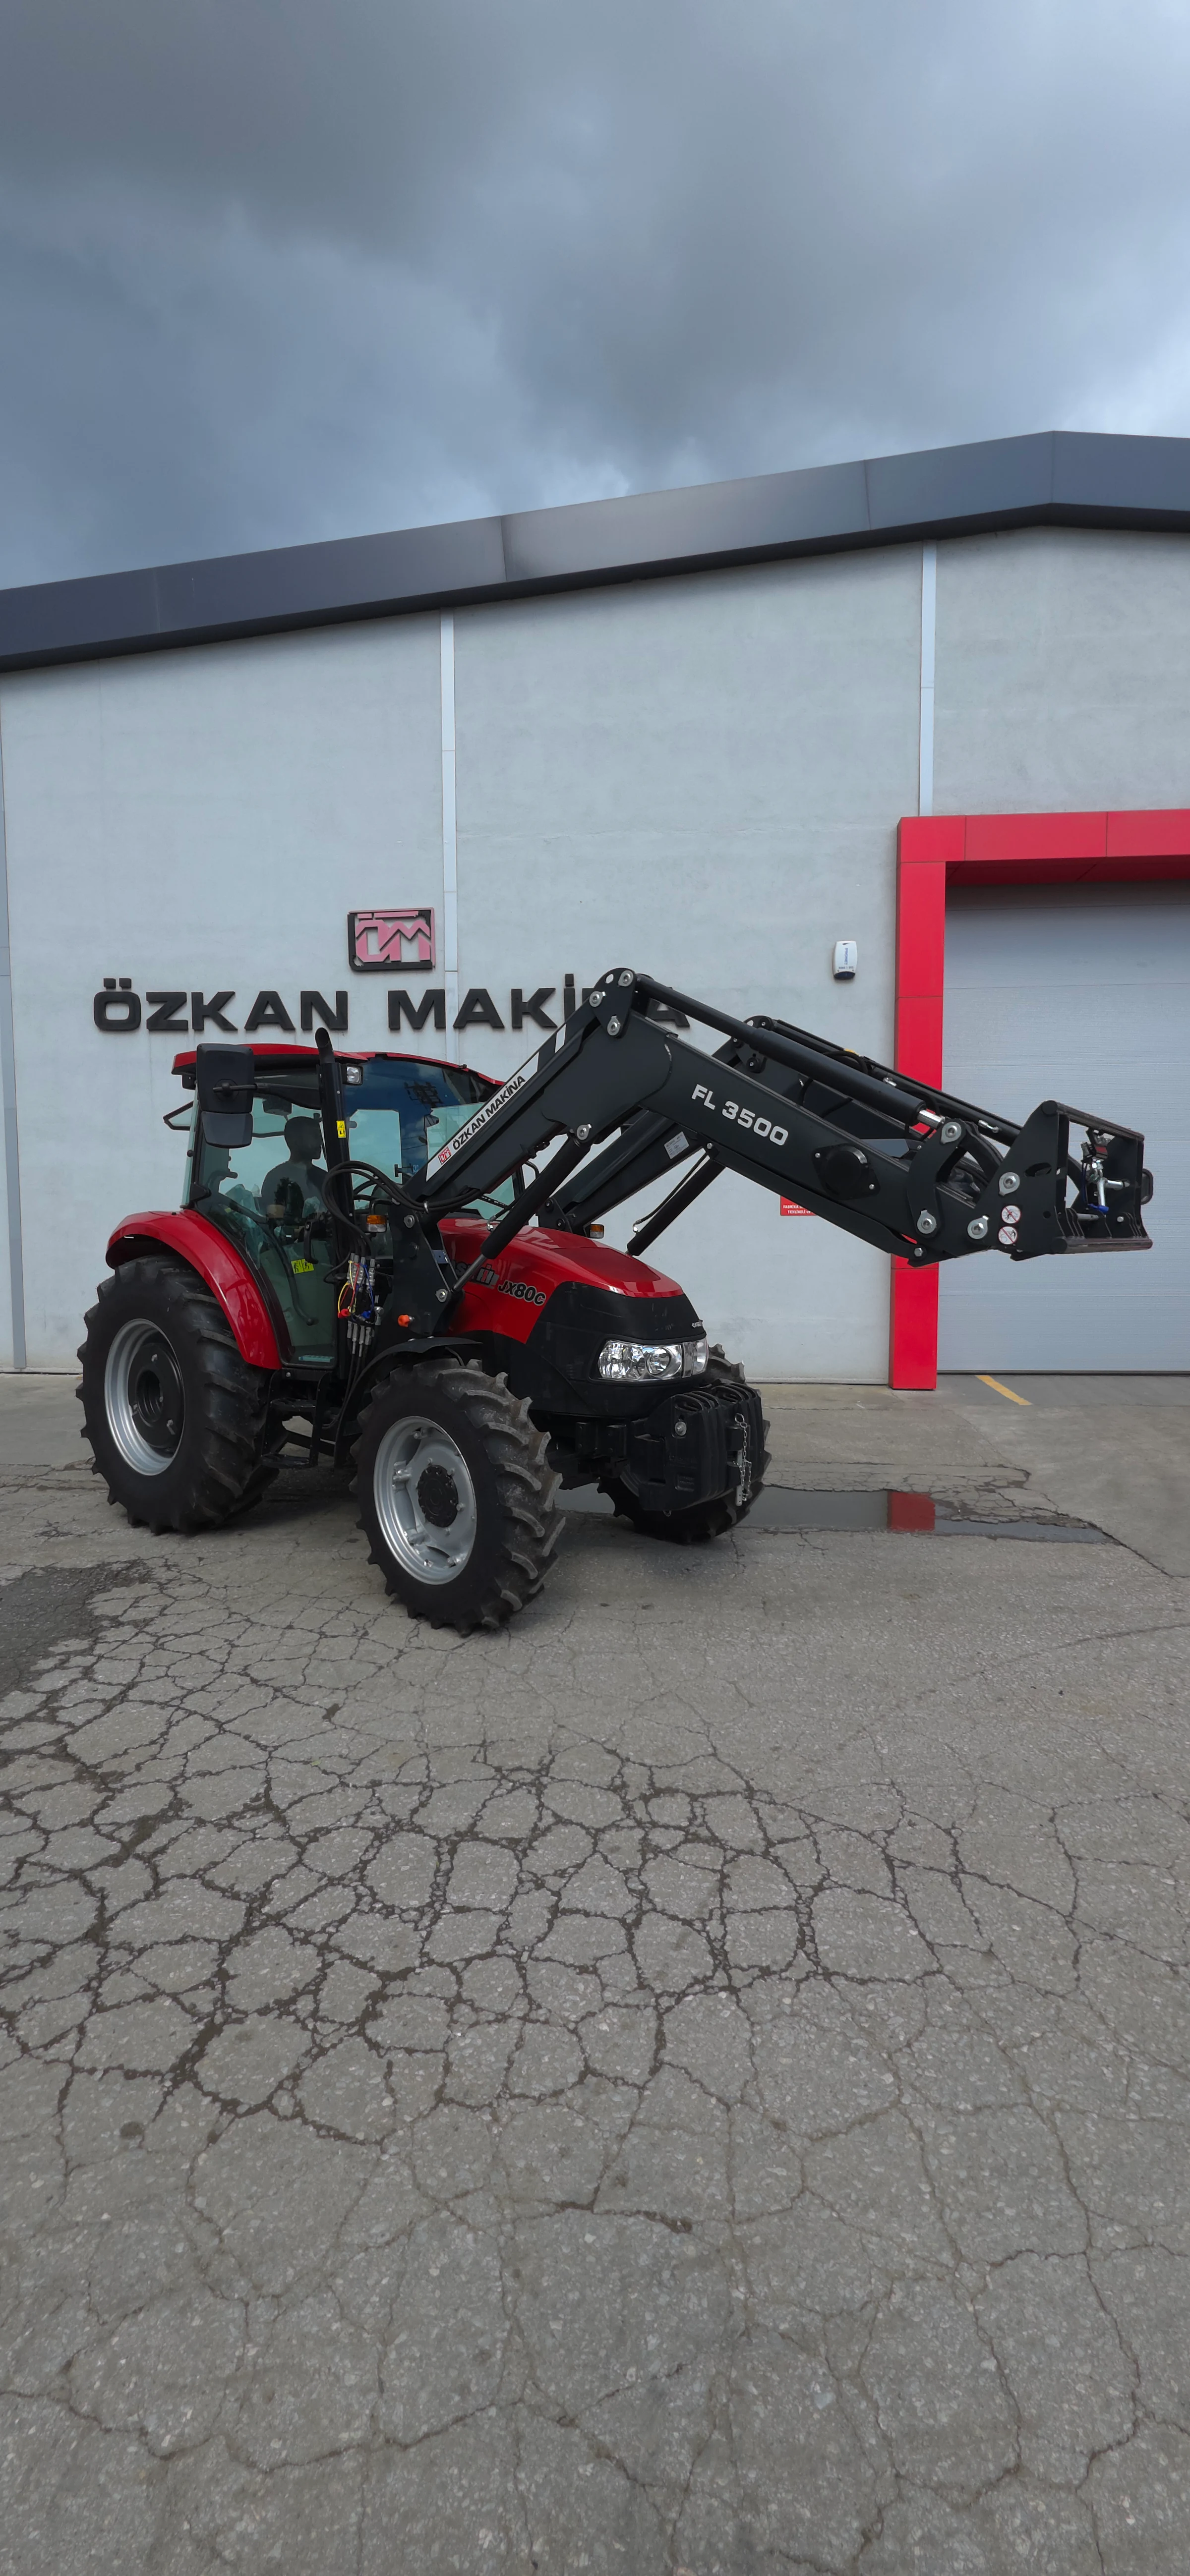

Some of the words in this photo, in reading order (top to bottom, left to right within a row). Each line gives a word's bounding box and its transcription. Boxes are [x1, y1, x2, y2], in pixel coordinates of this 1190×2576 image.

[93, 977, 348, 1031] ÖZKAN
[388, 973, 690, 1031] MAKİA
[452, 1114, 486, 1150] ÖZKAN
[484, 1075, 526, 1118] MAKİNA
[691, 1084, 715, 1110] FL
[722, 1100, 789, 1146] 3500
[498, 1279, 546, 1306] JX80C
